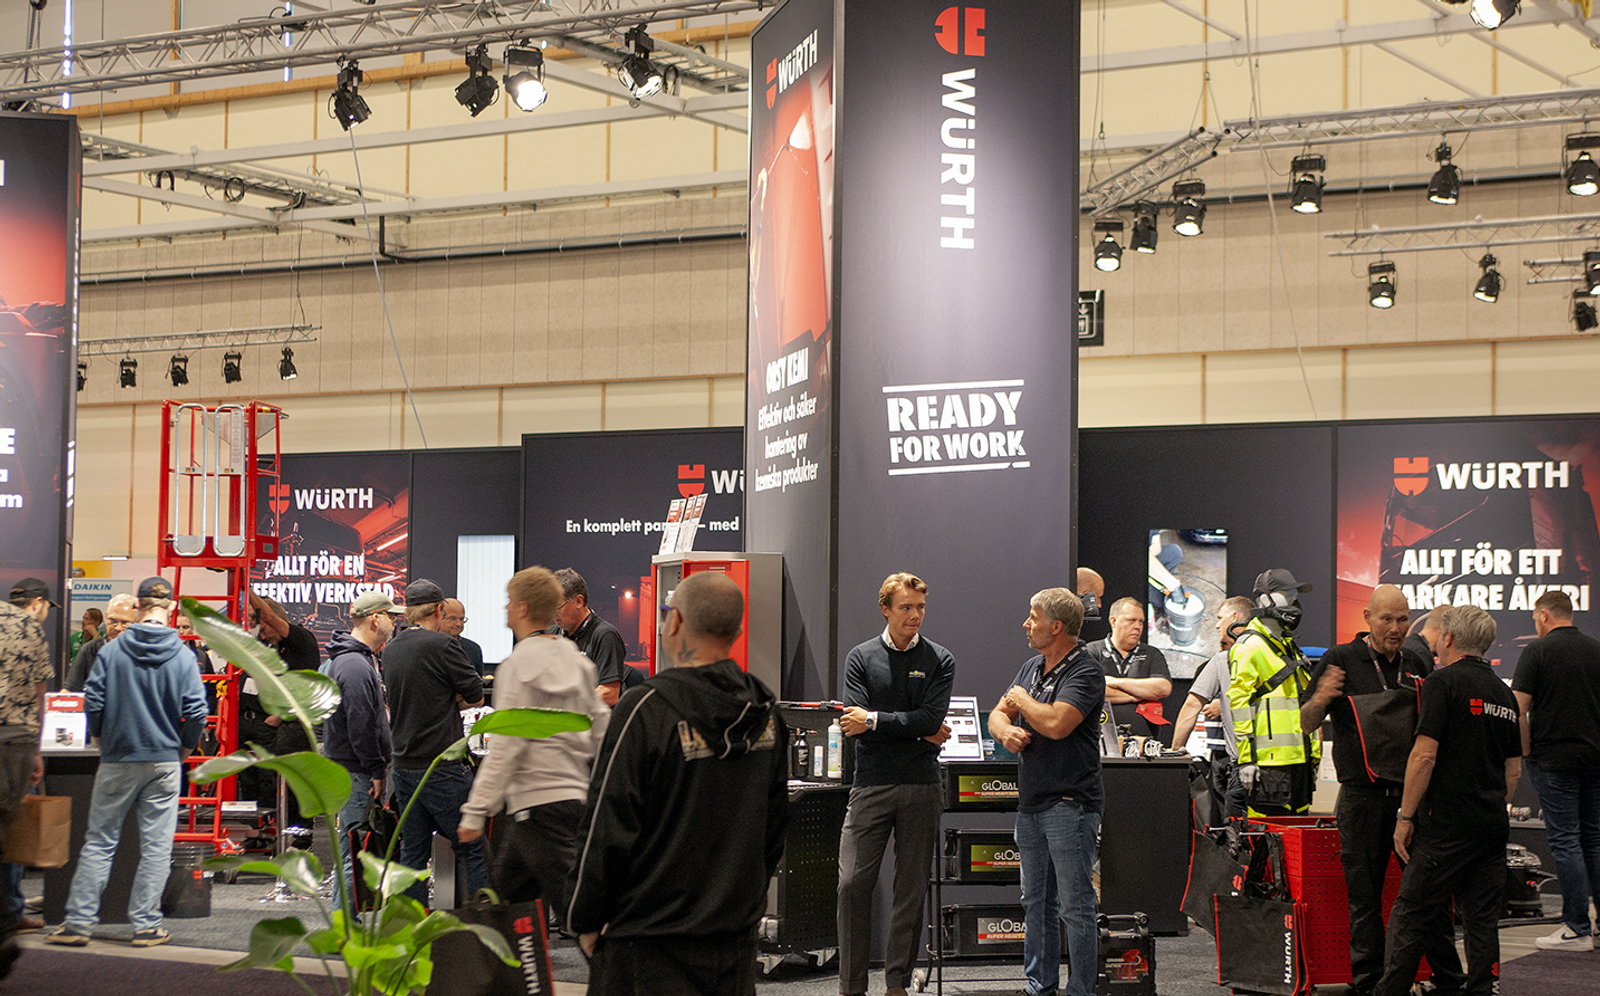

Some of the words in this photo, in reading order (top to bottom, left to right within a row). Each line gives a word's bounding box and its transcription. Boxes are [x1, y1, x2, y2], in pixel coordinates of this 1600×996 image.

[778, 28, 818, 94] WÜRTH
[940, 68, 976, 250] WÜRTH
[787, 347, 809, 387] KEMI
[758, 401, 783, 431] Effektiv
[783, 396, 796, 423] och
[797, 391, 817, 419] säker
[887, 390, 1022, 432] READY
[765, 430, 797, 460] hantering
[798, 432, 808, 451] av
[889, 435, 942, 464] FOR
[943, 430, 1027, 461] WORK
[711, 470, 744, 494] W
[755, 464, 782, 492] kemiska
[782, 456, 819, 493] produkter
[1436, 461, 1569, 490] WÜRTH
[294, 488, 374, 510] WÜRTH
[566, 520, 581, 533] En
[584, 518, 641, 536] komplett
[709, 517, 739, 532] med
[273, 555, 307, 576] ALLT
[310, 550, 342, 576] FÖR
[344, 555, 365, 576] EN
[1400, 549, 1456, 575] ALLT
[1461, 541, 1513, 576] FÖR
[1518, 548, 1563, 575] ETT
[250, 583, 312, 603] FFEKTIV
[1374, 583, 1504, 611] ARKARE
[1508, 576, 1590, 611] ÅKRI
[981, 780, 1018, 791] GLOBAL
[993, 849, 1021, 860] GLOB
[987, 919, 1026, 932] GLOBA
